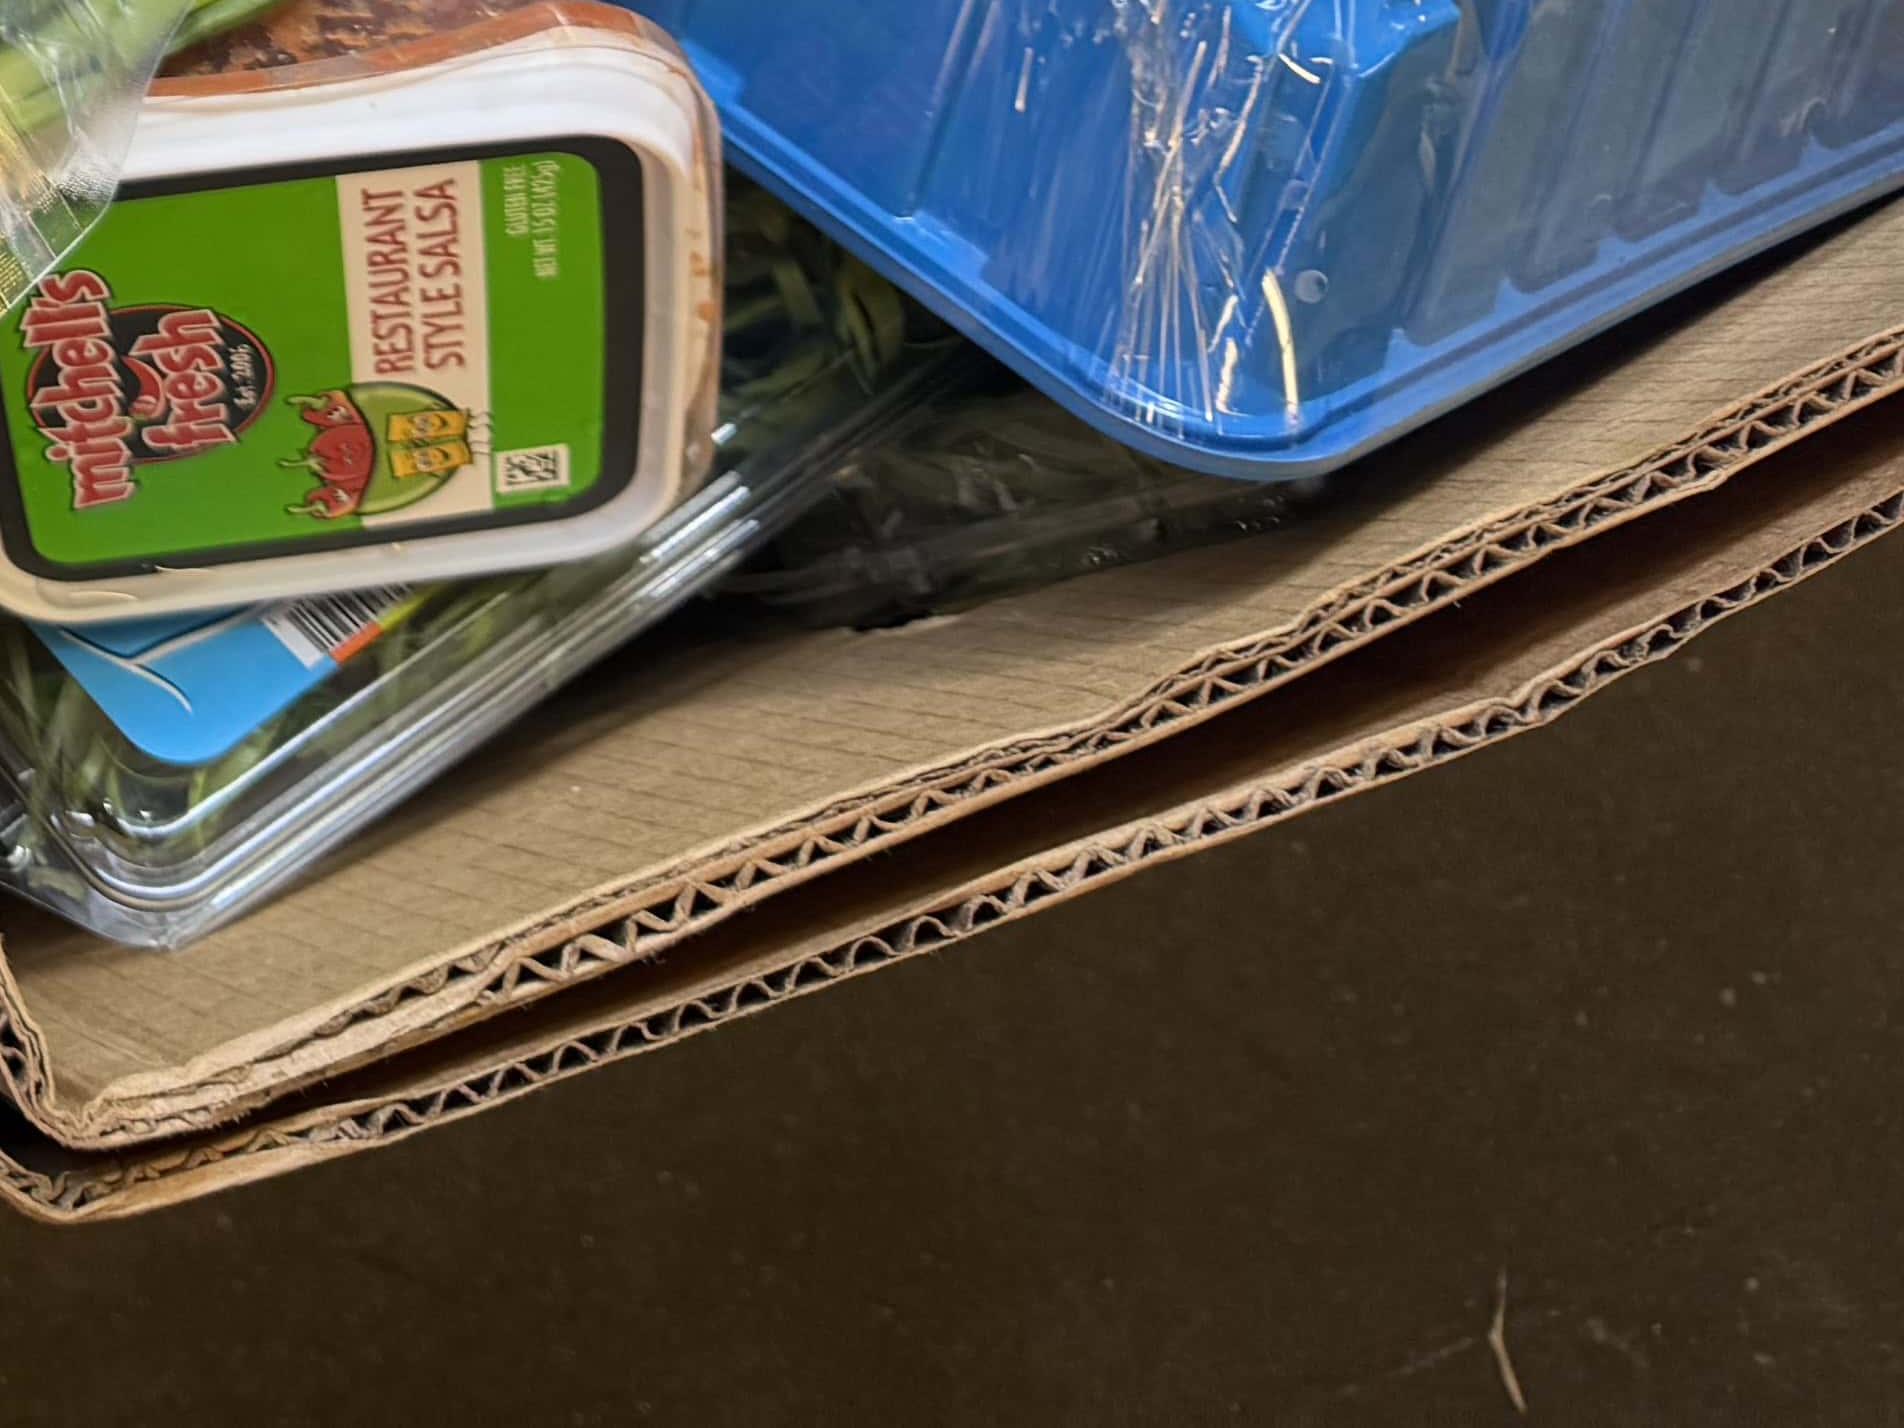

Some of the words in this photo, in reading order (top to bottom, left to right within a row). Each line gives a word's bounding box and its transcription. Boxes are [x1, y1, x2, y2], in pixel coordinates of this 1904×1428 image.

[362, 188, 417, 374] RESTAURANT
[413, 178, 461, 278] SALSA
[18, 267, 137, 512] mitchell's
[129, 307, 239, 453] fresh
[419, 283, 465, 370] STYLE
